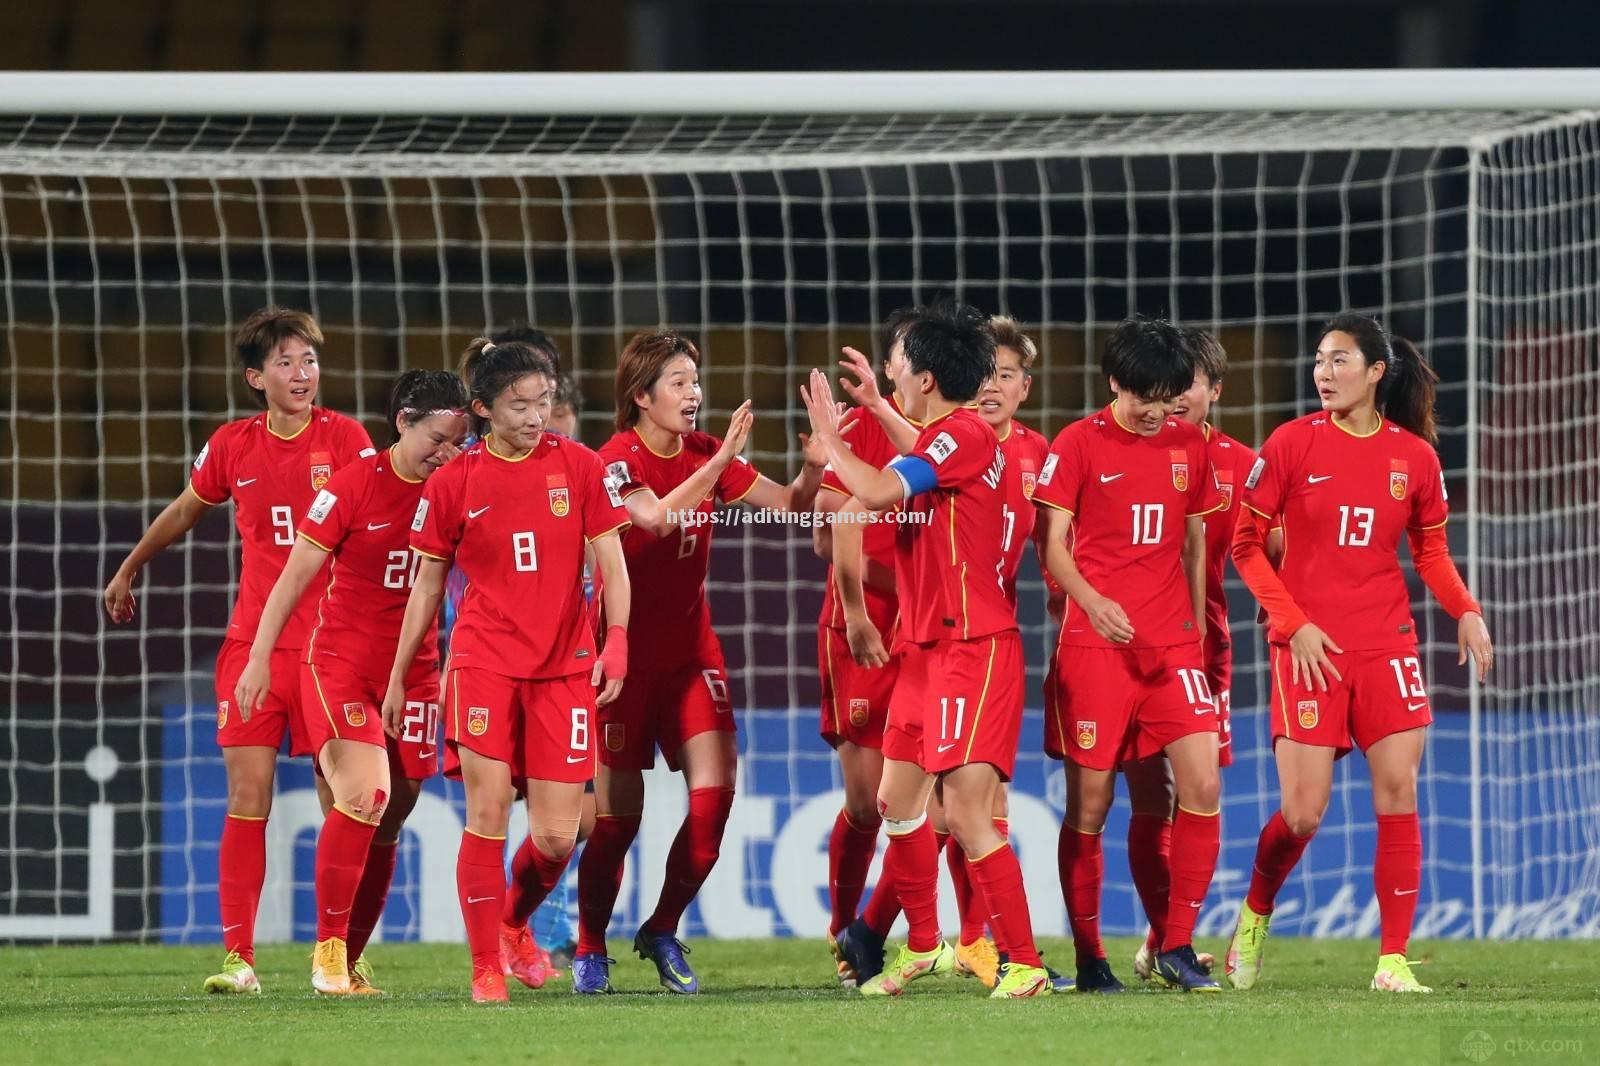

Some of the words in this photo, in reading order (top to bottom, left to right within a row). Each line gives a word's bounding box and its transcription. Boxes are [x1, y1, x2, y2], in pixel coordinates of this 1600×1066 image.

[271, 505, 295, 546] 9
[677, 516, 698, 560] 6
[1131, 503, 1164, 545] 10
[1338, 505, 1375, 547] 13
[512, 531, 538, 572] 8
[702, 668, 728, 702] 6
[1176, 668, 1214, 706] 10
[1389, 656, 1427, 698] 13
[402, 700, 439, 745] 20
[570, 707, 588, 751] 8
[940, 697, 966, 740] 11
